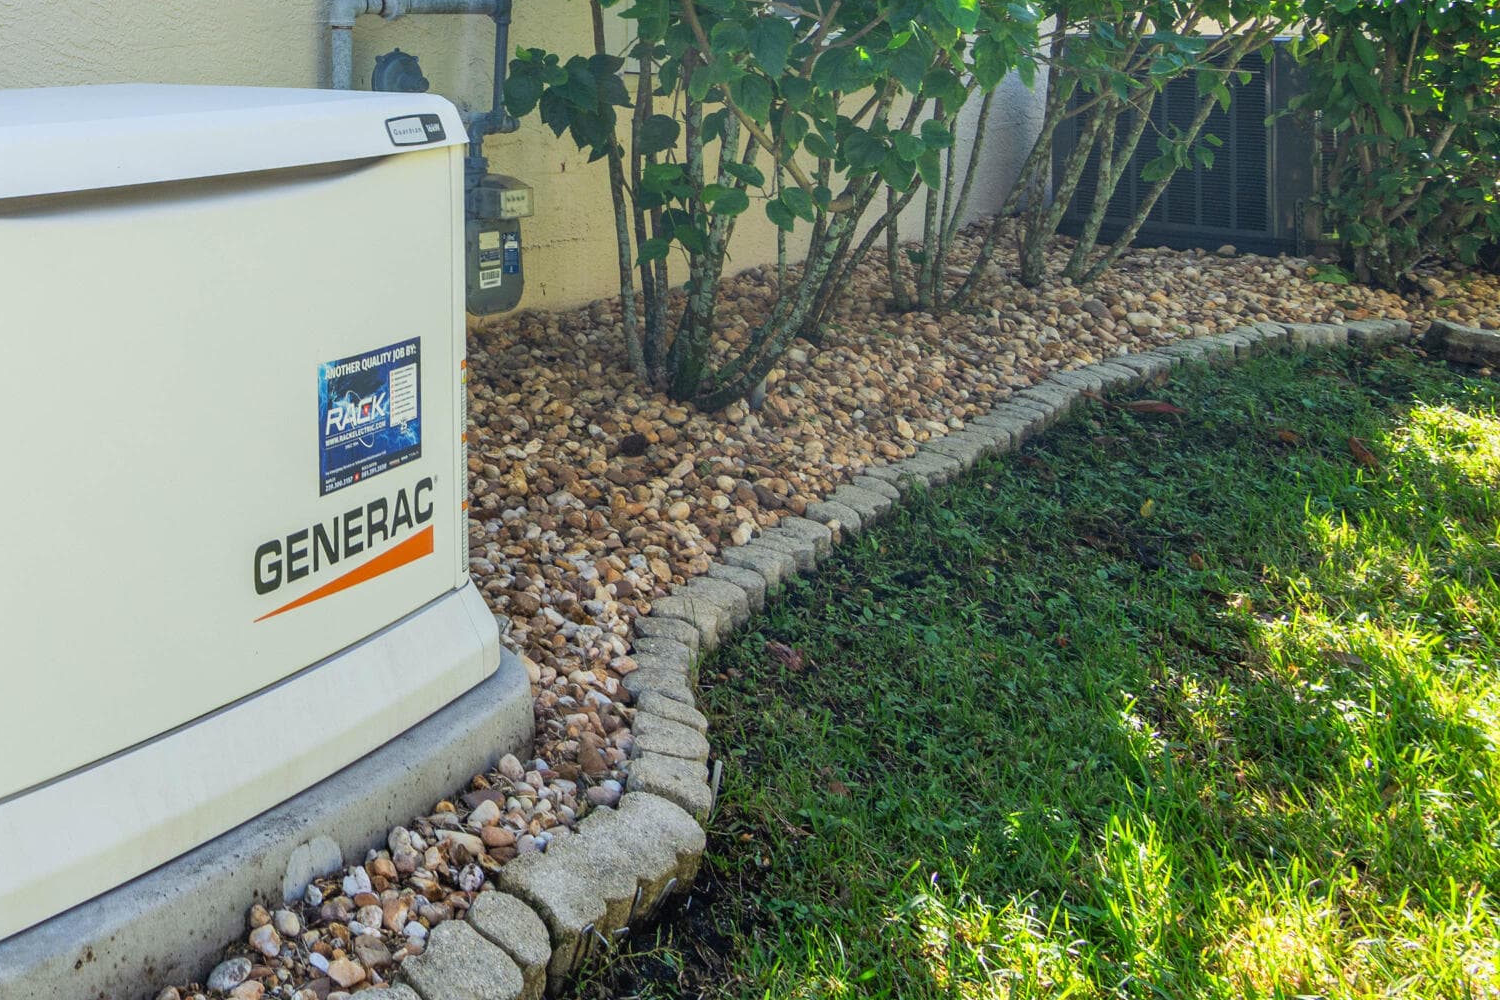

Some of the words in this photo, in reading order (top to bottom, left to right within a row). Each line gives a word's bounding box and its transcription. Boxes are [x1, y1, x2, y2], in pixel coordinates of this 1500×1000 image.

[393, 127, 423, 136] Guardian
[325, 359, 361, 380] ANOTHER
[362, 352, 392, 371] QUALITY
[392, 347, 405, 363] JOB
[405, 343, 417, 357] BY:
[325, 391, 386, 436] RACK
[253, 475, 435, 596] GENERAC
